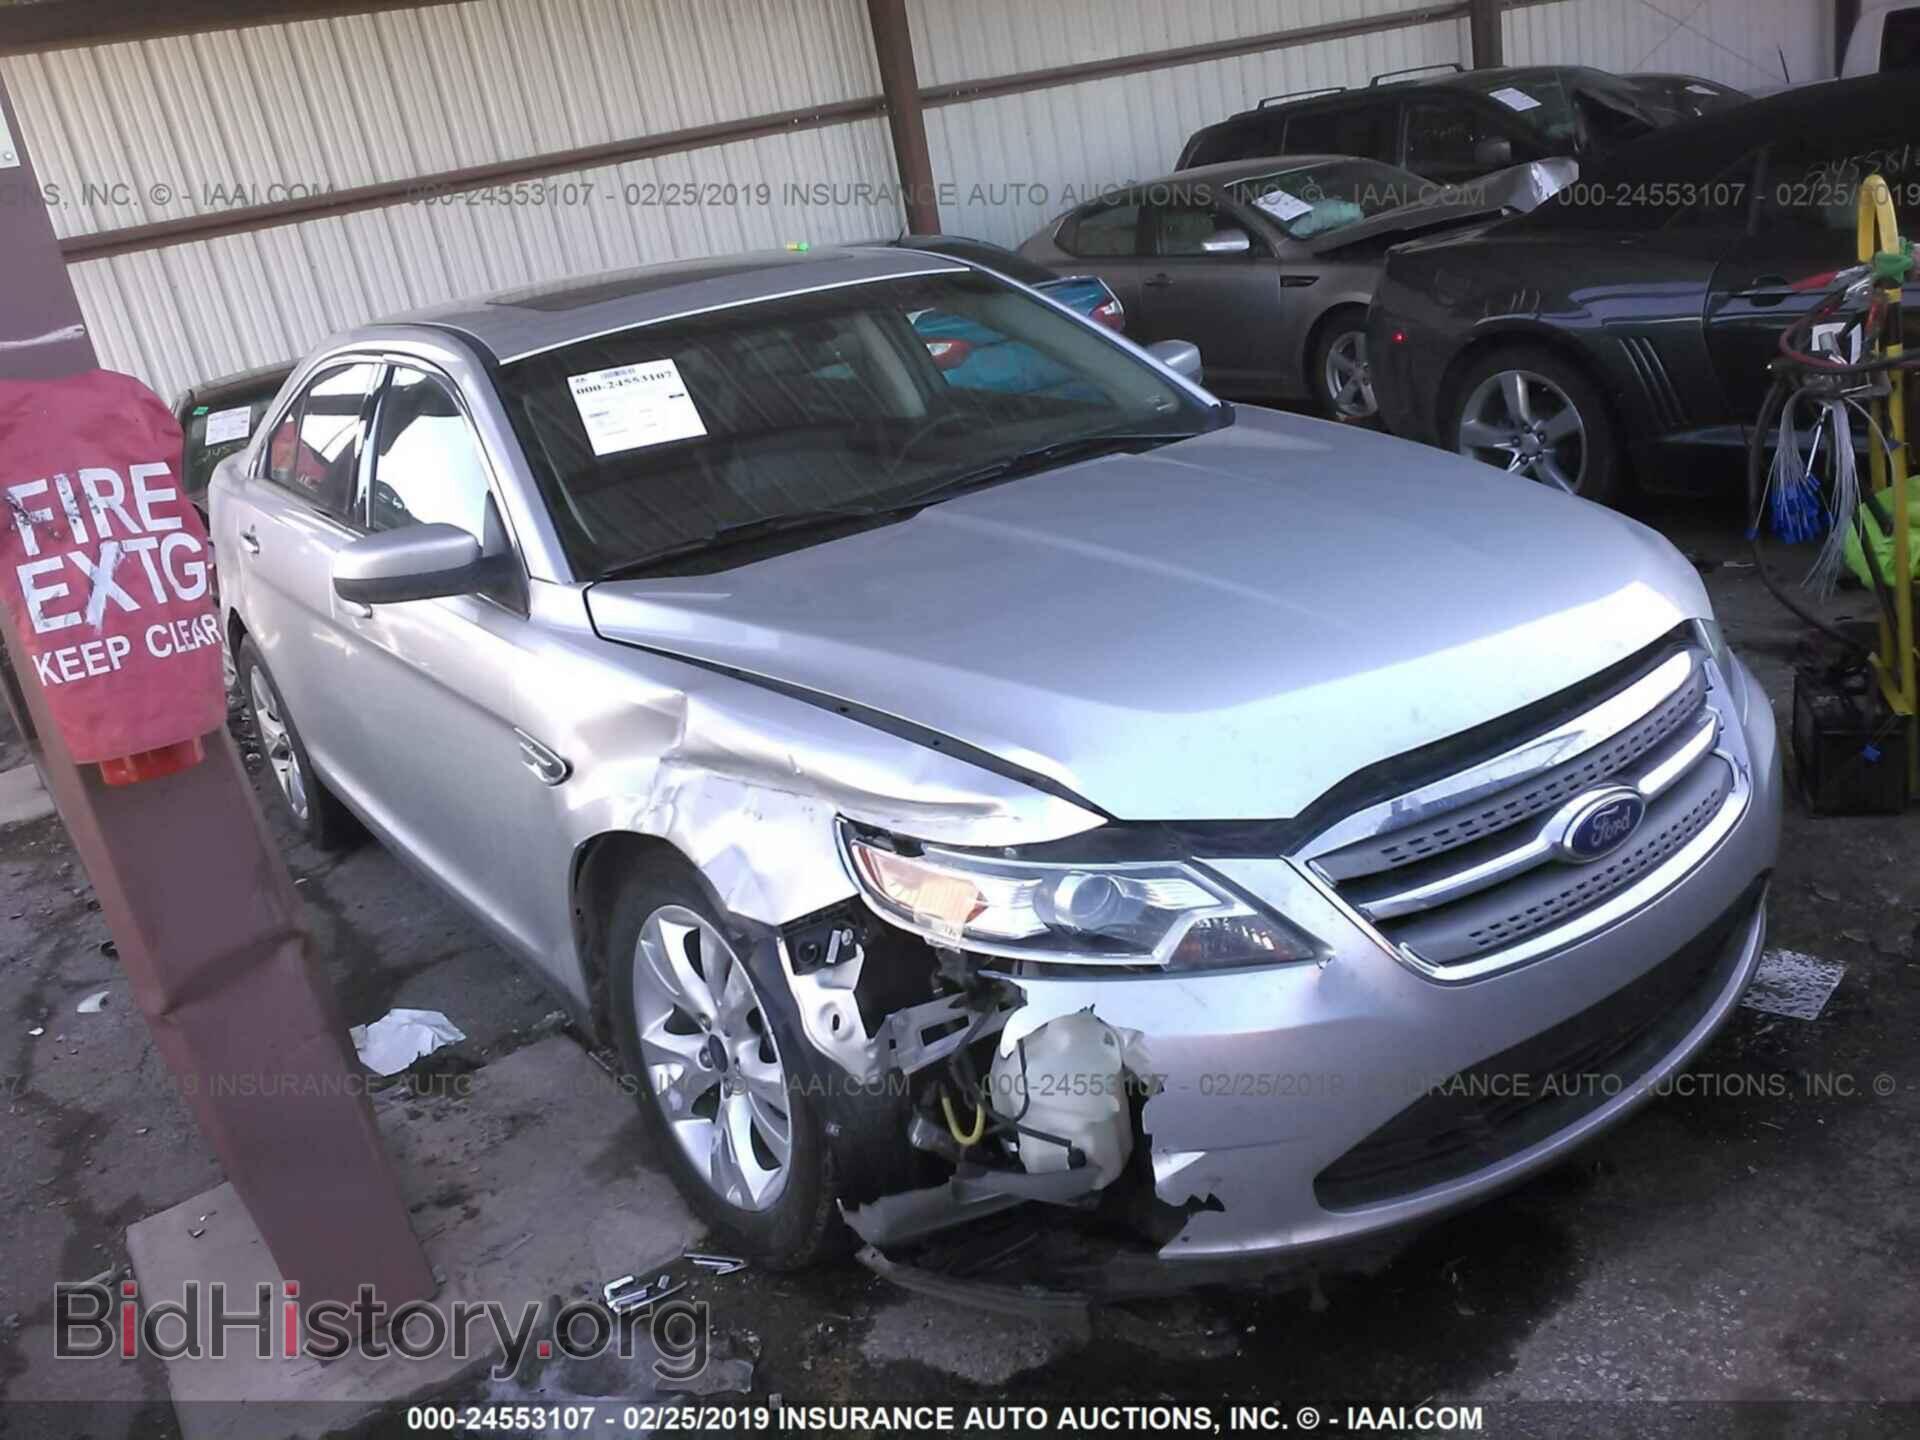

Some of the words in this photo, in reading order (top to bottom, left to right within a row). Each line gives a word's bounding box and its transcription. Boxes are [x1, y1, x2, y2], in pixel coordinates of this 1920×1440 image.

[576, 370, 673, 396] 000-24553107
[7, 462, 182, 556] FIRE
[16, 532, 208, 634] EXTG
[32, 635, 131, 686] KEEP
[145, 613, 222, 659] CLEAR
[1591, 805, 1631, 848] Ford
